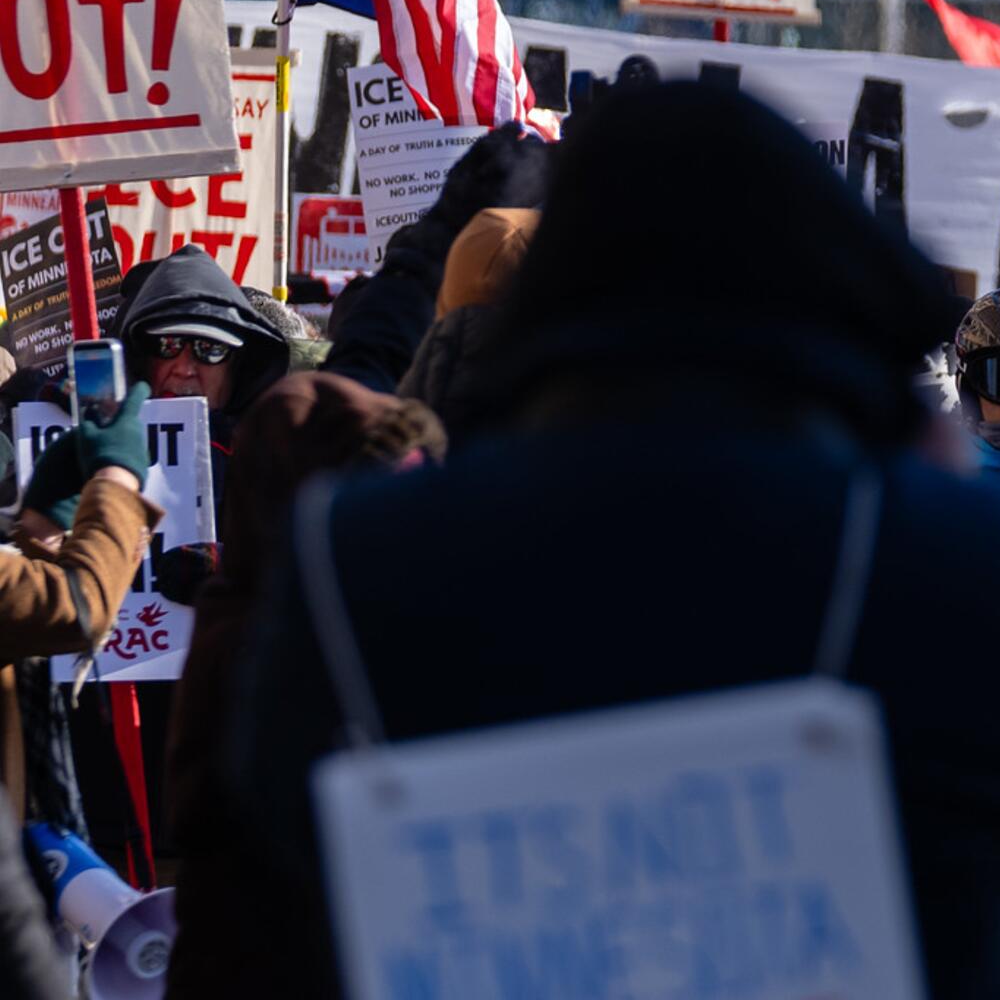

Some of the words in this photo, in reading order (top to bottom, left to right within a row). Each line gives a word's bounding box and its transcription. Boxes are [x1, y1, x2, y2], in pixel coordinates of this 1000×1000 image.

[354, 77, 404, 108] ICE
[360, 112, 381, 129] OF
[360, 150, 367, 158] A
[368, 146, 386, 157] DAY
[388, 144, 401, 154] OF
[405, 139, 434, 151] TRUTH
[436, 138, 443, 148] &
[445, 136, 480, 147] FREEDO
[365, 178, 381, 189] NO
[384, 173, 420, 185] WORK.
[424, 169, 440, 181] NO
[390, 187, 406, 199] NO
[1, 235, 43, 278] ICE
[47, 209, 106, 254] OT
[8, 280, 26, 299] OF
[12, 313, 18, 322] A
[18, 305, 33, 319] DAY
[33, 300, 45, 311] OF
[15, 337, 28, 351] NO
[34, 342, 50, 354] NO
[103, 628, 170, 660] RAC
